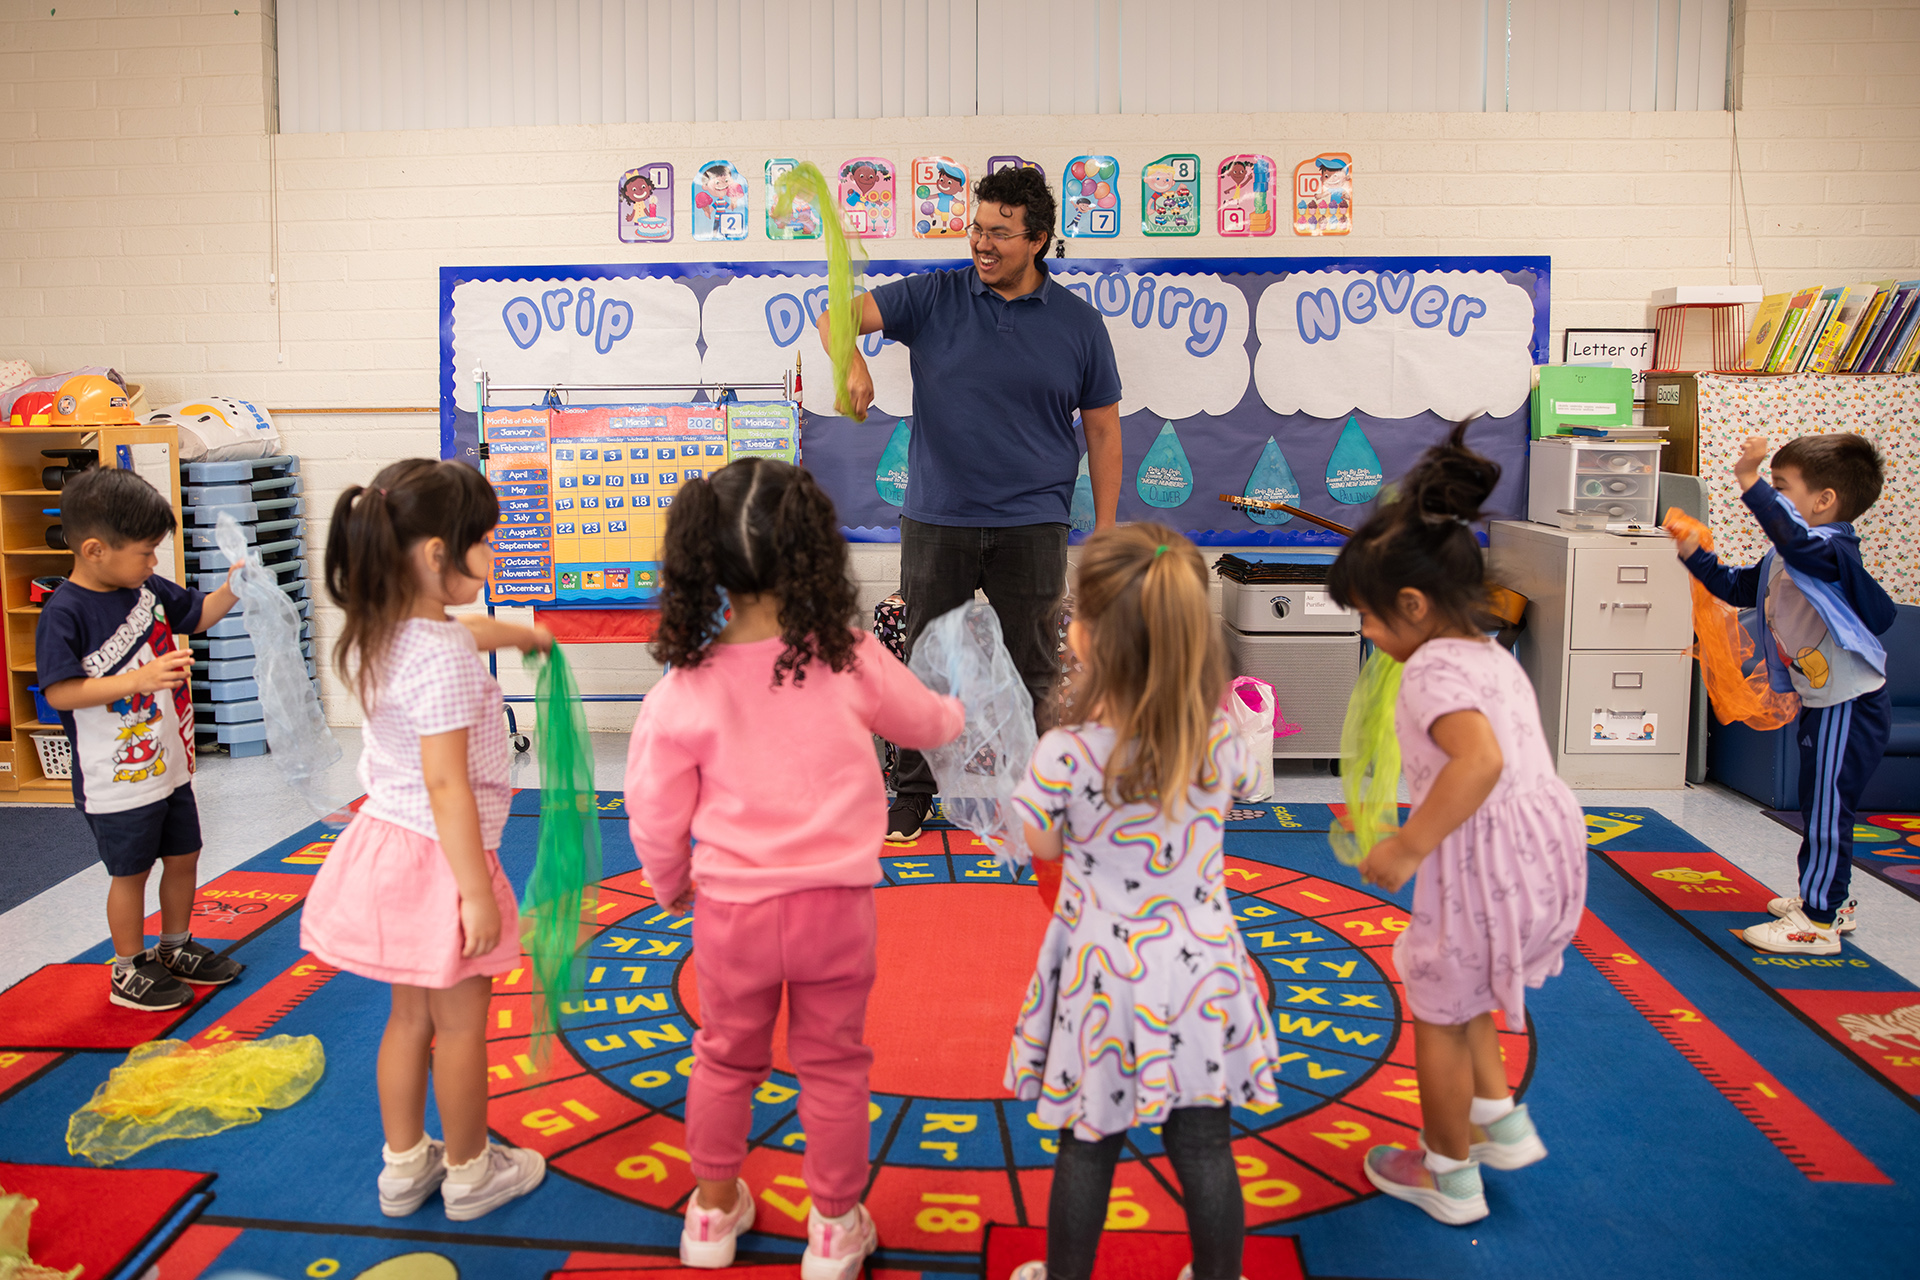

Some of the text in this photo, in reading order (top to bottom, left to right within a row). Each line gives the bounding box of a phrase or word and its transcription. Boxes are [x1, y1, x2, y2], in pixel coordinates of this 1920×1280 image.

[656, 169, 664, 185] 1
[923, 166, 934, 180] 5
[1178, 163, 1189, 178] 8
[1304, 177, 1319, 192] 10
[726, 217, 736, 232] 2
[850, 214, 861, 229] 4
[1098, 215, 1109, 229] 7
[1229, 212, 1240, 227] 9
[1296, 270, 1487, 344] Never
[502, 287, 634, 354] Drip
[1573, 342, 1648, 358] Letter of
[1657, 388, 1679, 402] Books
[628, 405, 650, 413] Month
[486, 416, 513, 425] Months
[531, 416, 548, 424] Year
[625, 417, 724, 431] March 2026
[745, 418, 776, 427] Monday
[500, 427, 533, 437] January
[500, 443, 536, 453] February
[744, 440, 776, 449] Tuesday
[562, 445, 718, 460] 1 2 3 4 5 6 7
[508, 470, 528, 480] April
[888, 469, 900, 477] Drip
[1148, 465, 1160, 473] Drip
[1336, 469, 1348, 477] Drip
[1349, 468, 1357, 476] By
[565, 470, 699, 487] 8 9 10 11 12 13
[511, 486, 528, 495] May
[885, 487, 906, 501] DIE
[1149, 485, 1181, 504] OLIVER
[1267, 487, 1274, 495] By
[1339, 489, 1372, 503] PAULINA
[509, 502, 529, 510] June
[558, 496, 673, 509] 15 16 17 18 19
[513, 514, 531, 523] July
[508, 527, 538, 539] August
[558, 521, 625, 533] 22 23 24
[498, 541, 543, 552] September
[505, 557, 540, 567] October
[502, 569, 541, 578] November
[504, 584, 544, 593] December
[1271, 805, 1303, 828] grapes
[1223, 867, 1263, 881] 2
[202, 889, 299, 903] bicycle
[1677, 883, 1741, 895] fish
[1299, 890, 1331, 903] 1
[1343, 916, 1411, 937] 26
[600, 936, 683, 957] Kk
[1246, 930, 1326, 949] Zz
[1611, 952, 1640, 966] 3
[1752, 955, 1871, 969] square
[290, 964, 318, 977] 3
[1271, 957, 1359, 978] Yy
[125, 973, 155, 999] N
[1285, 984, 1383, 1009] Xx
[1668, 1008, 1702, 1023] 2
[203, 1025, 234, 1041] 4
[1278, 1012, 1383, 1046] Ww
[584, 1023, 688, 1052] Nn
[1752, 1082, 1780, 1099] 1
[520, 1098, 601, 1137] 15
[614, 1141, 693, 1184] 16
[914, 1192, 981, 1234] 18
